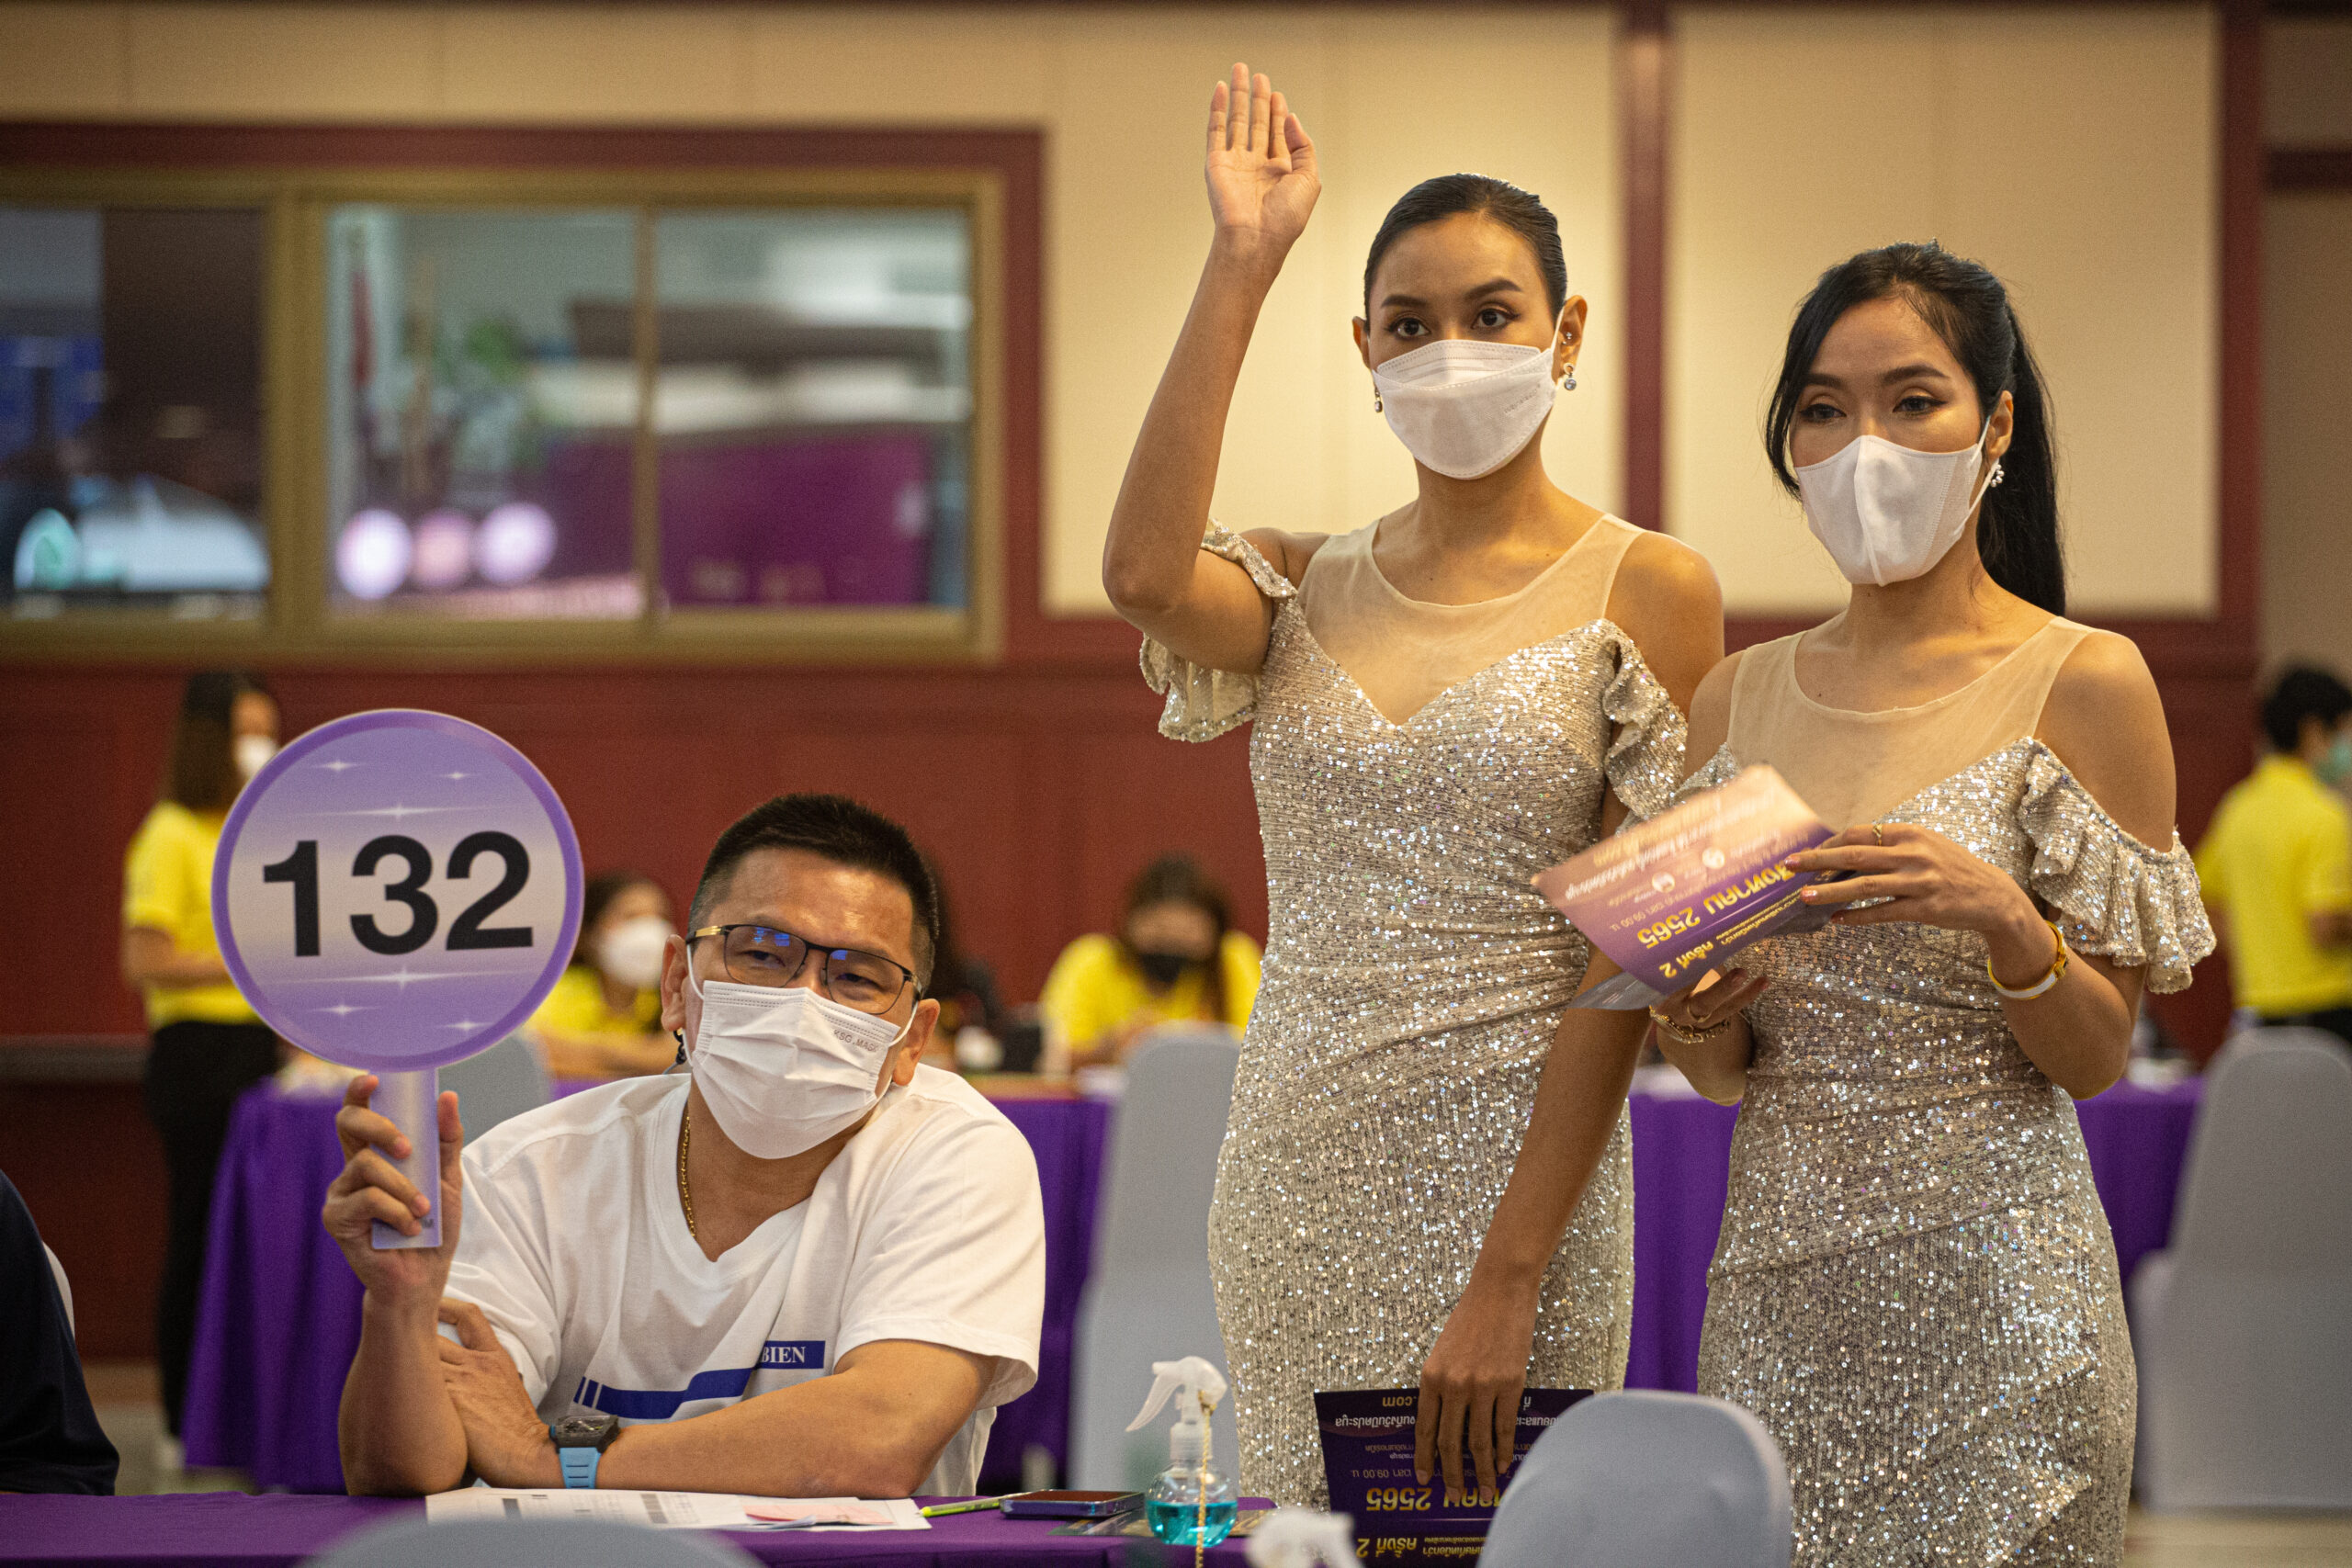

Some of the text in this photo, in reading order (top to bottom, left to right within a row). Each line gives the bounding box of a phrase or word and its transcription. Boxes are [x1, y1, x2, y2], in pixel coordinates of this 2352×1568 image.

[262, 830, 534, 957] 132
[1637, 906, 1701, 949] 2565
[1658, 941, 1713, 978] ครั้งที่ 2
[1363, 1469, 1389, 1478] 09.00
[1366, 1487, 1432, 1511] 2565
[1355, 1537, 1418, 1559] ครั้งที่ 2
